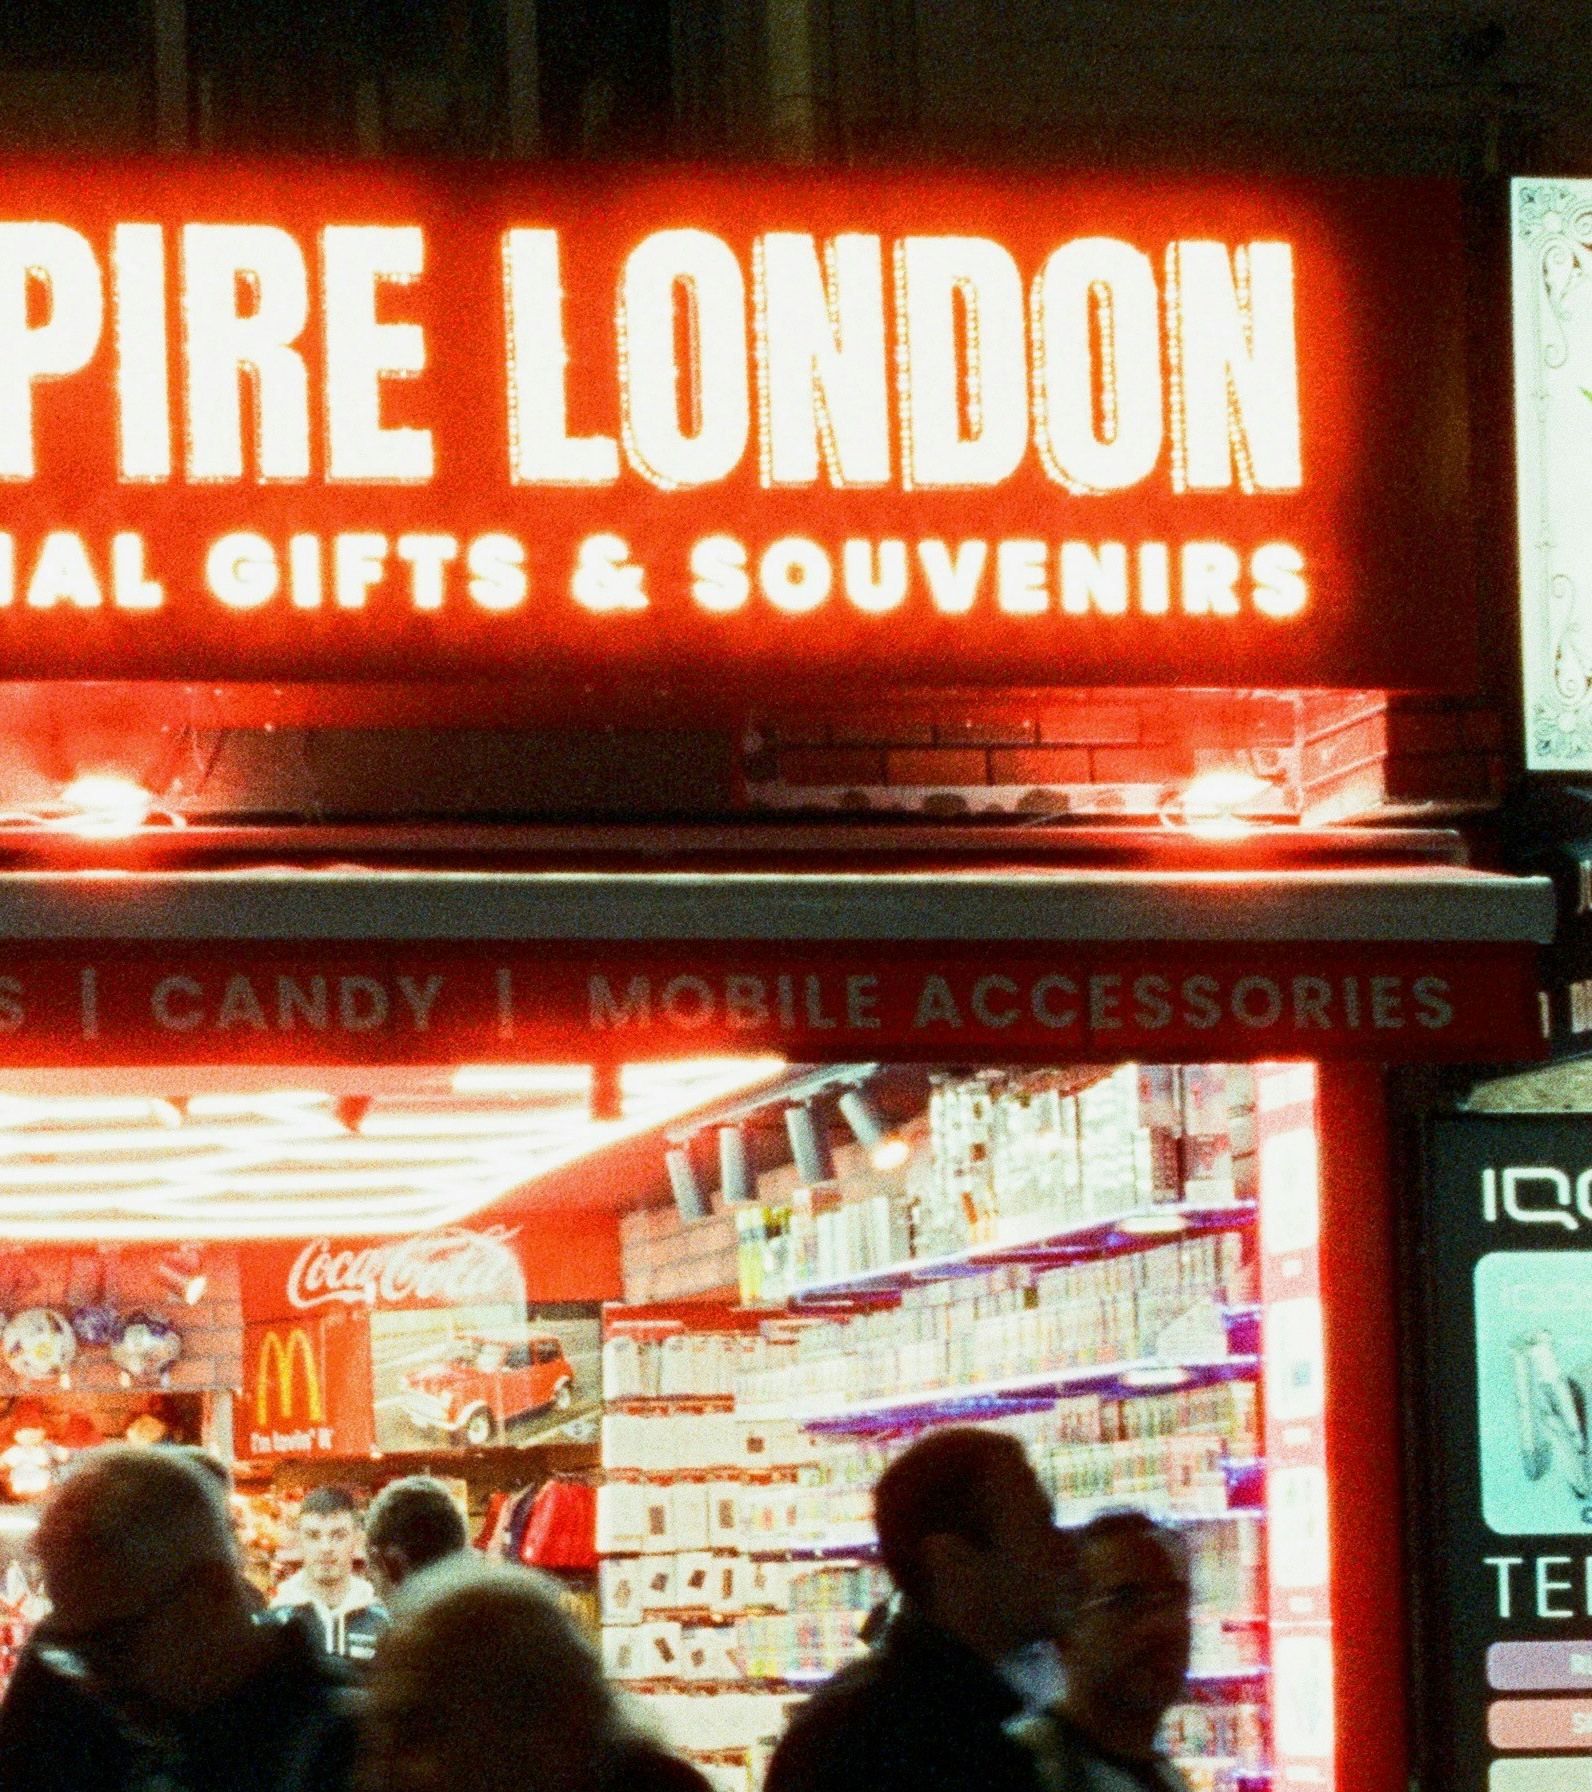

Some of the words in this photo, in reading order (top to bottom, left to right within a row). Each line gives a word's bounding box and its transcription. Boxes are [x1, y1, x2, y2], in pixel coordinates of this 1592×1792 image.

[502, 226, 1305, 494] LONDON
[205, 528, 529, 614] GIFTS
[570, 530, 650, 615] &
[690, 533, 1308, 621] SOUVENIRS
[150, 972, 445, 1034] CANDY
[586, 974, 881, 1031] MOBILE
[912, 972, 1455, 1031] ACCESSORIES
